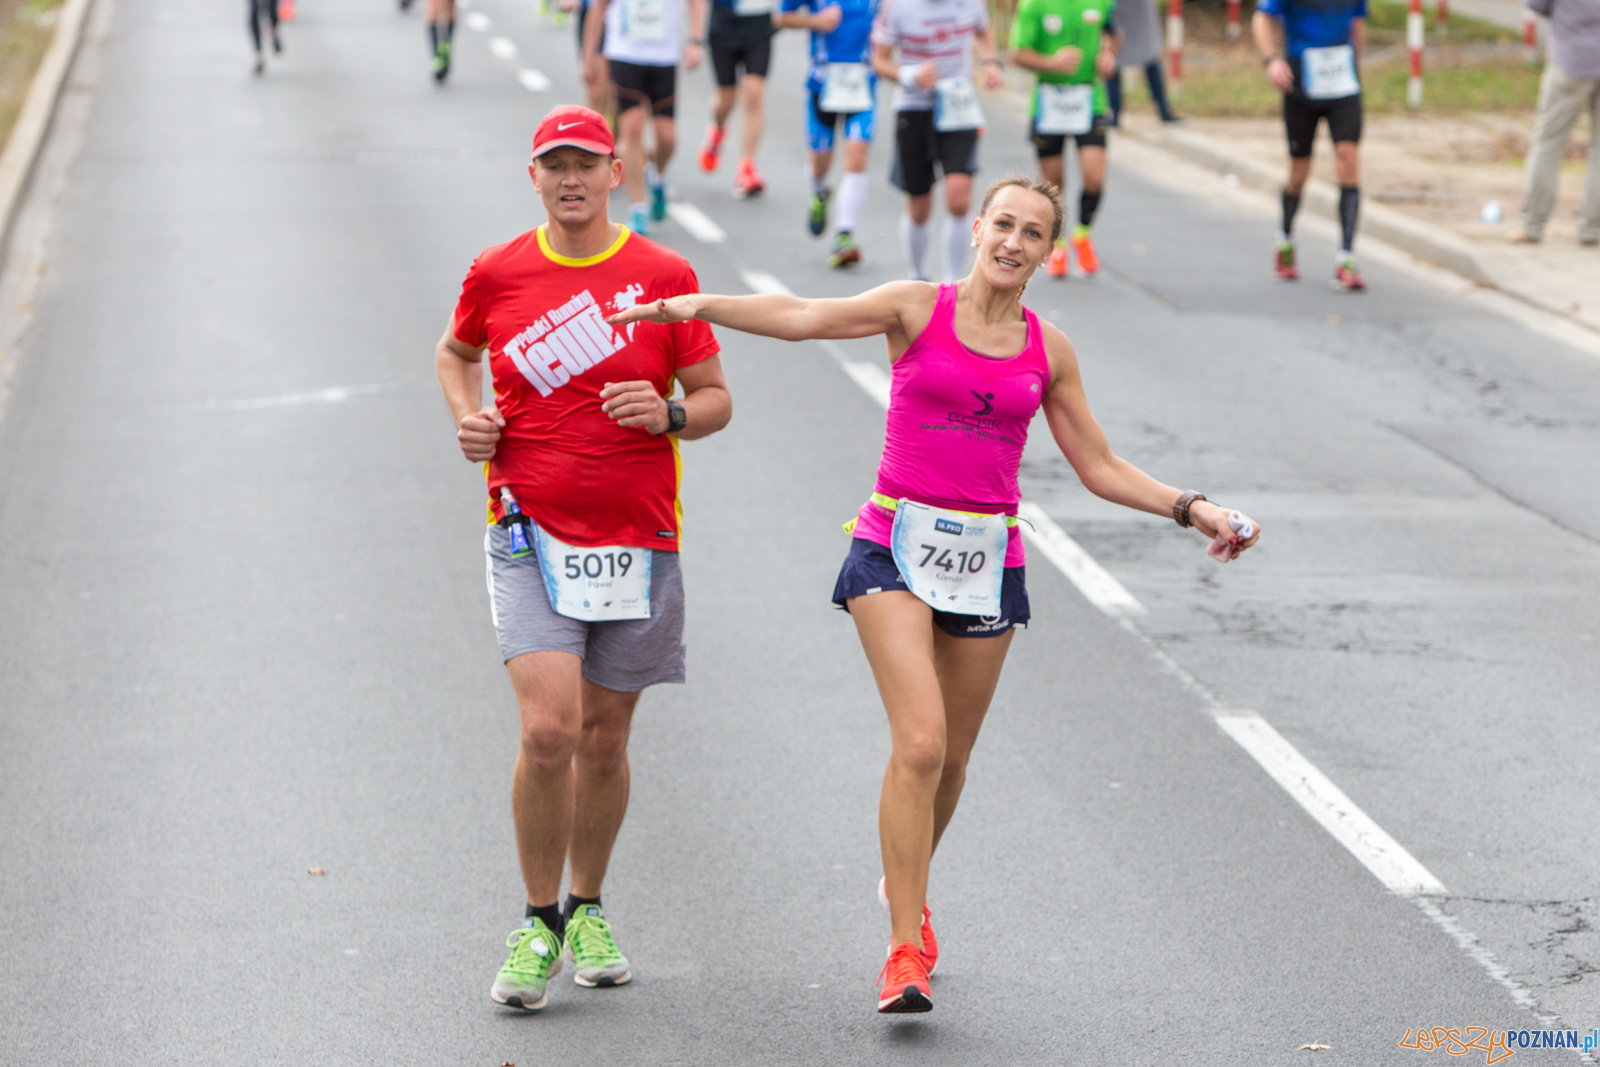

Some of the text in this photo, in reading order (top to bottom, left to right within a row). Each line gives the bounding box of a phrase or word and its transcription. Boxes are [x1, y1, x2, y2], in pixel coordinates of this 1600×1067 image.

[564, 552, 633, 580] 5019
[919, 543, 986, 574] 7410
[935, 573, 963, 583] Kamila
